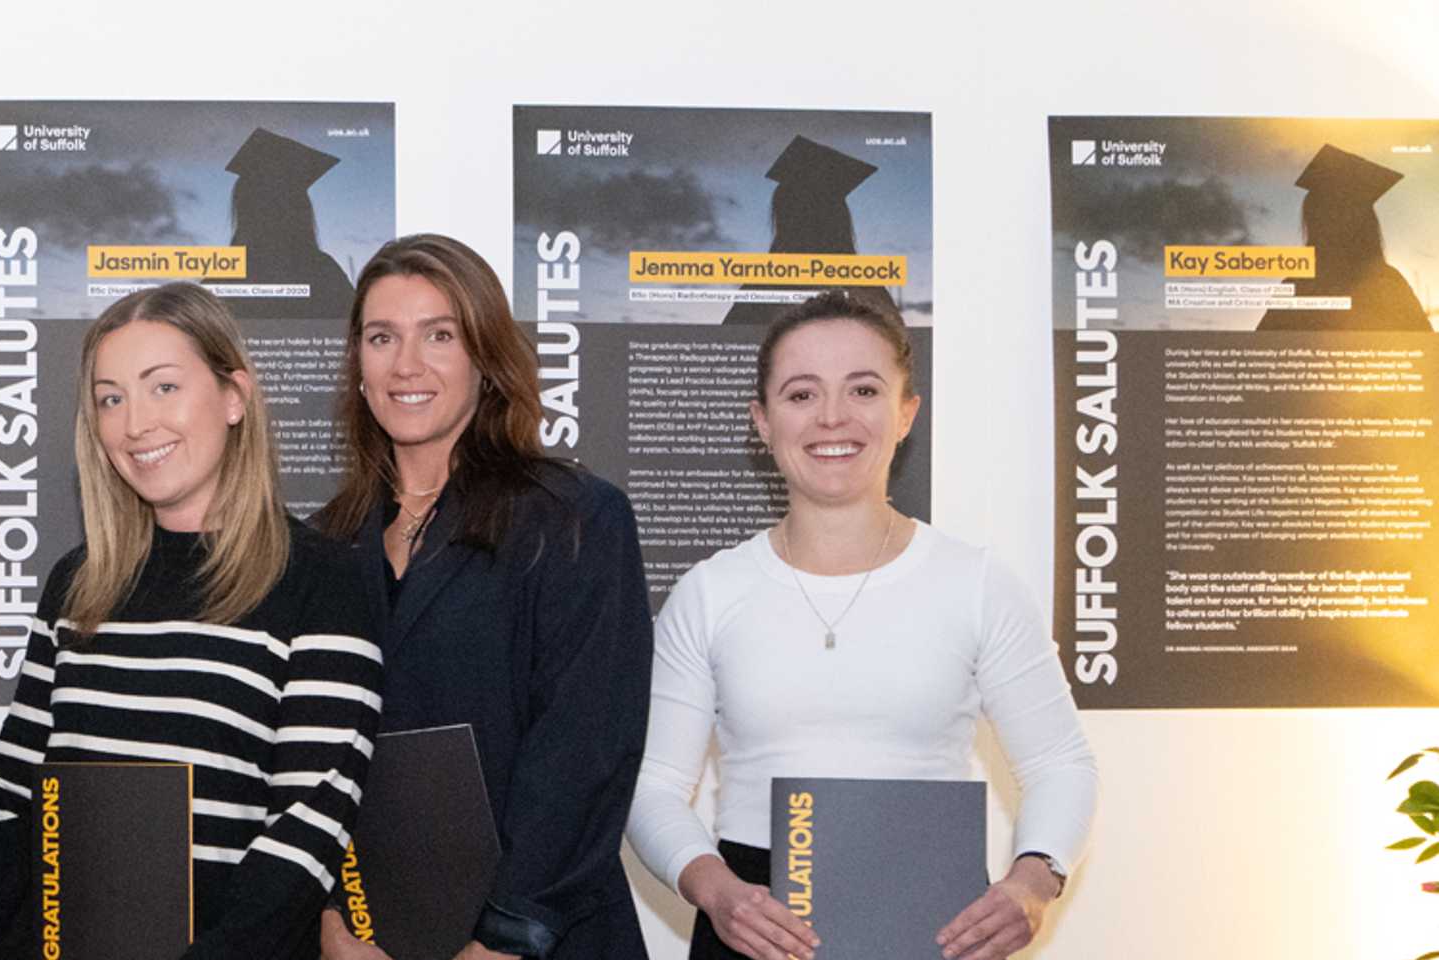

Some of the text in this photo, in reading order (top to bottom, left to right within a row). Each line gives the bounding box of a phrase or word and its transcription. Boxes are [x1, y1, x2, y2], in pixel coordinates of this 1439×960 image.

[24, 125, 90, 141] University
[568, 131, 633, 144] University
[24, 138, 85, 151] of Suffolk
[568, 144, 628, 156] of Suffolk
[1102, 141, 1166, 154] University
[1102, 154, 1161, 165] of Suffolk
[95, 252, 240, 275] Jasmin Taylor
[636, 257, 900, 279] Jemma Yarnton-Peacock
[1171, 252, 1309, 274] Kay Saberton
[537, 231, 580, 448] SALUTES
[1075, 240, 1118, 684] SUFFOLK SALUTES
